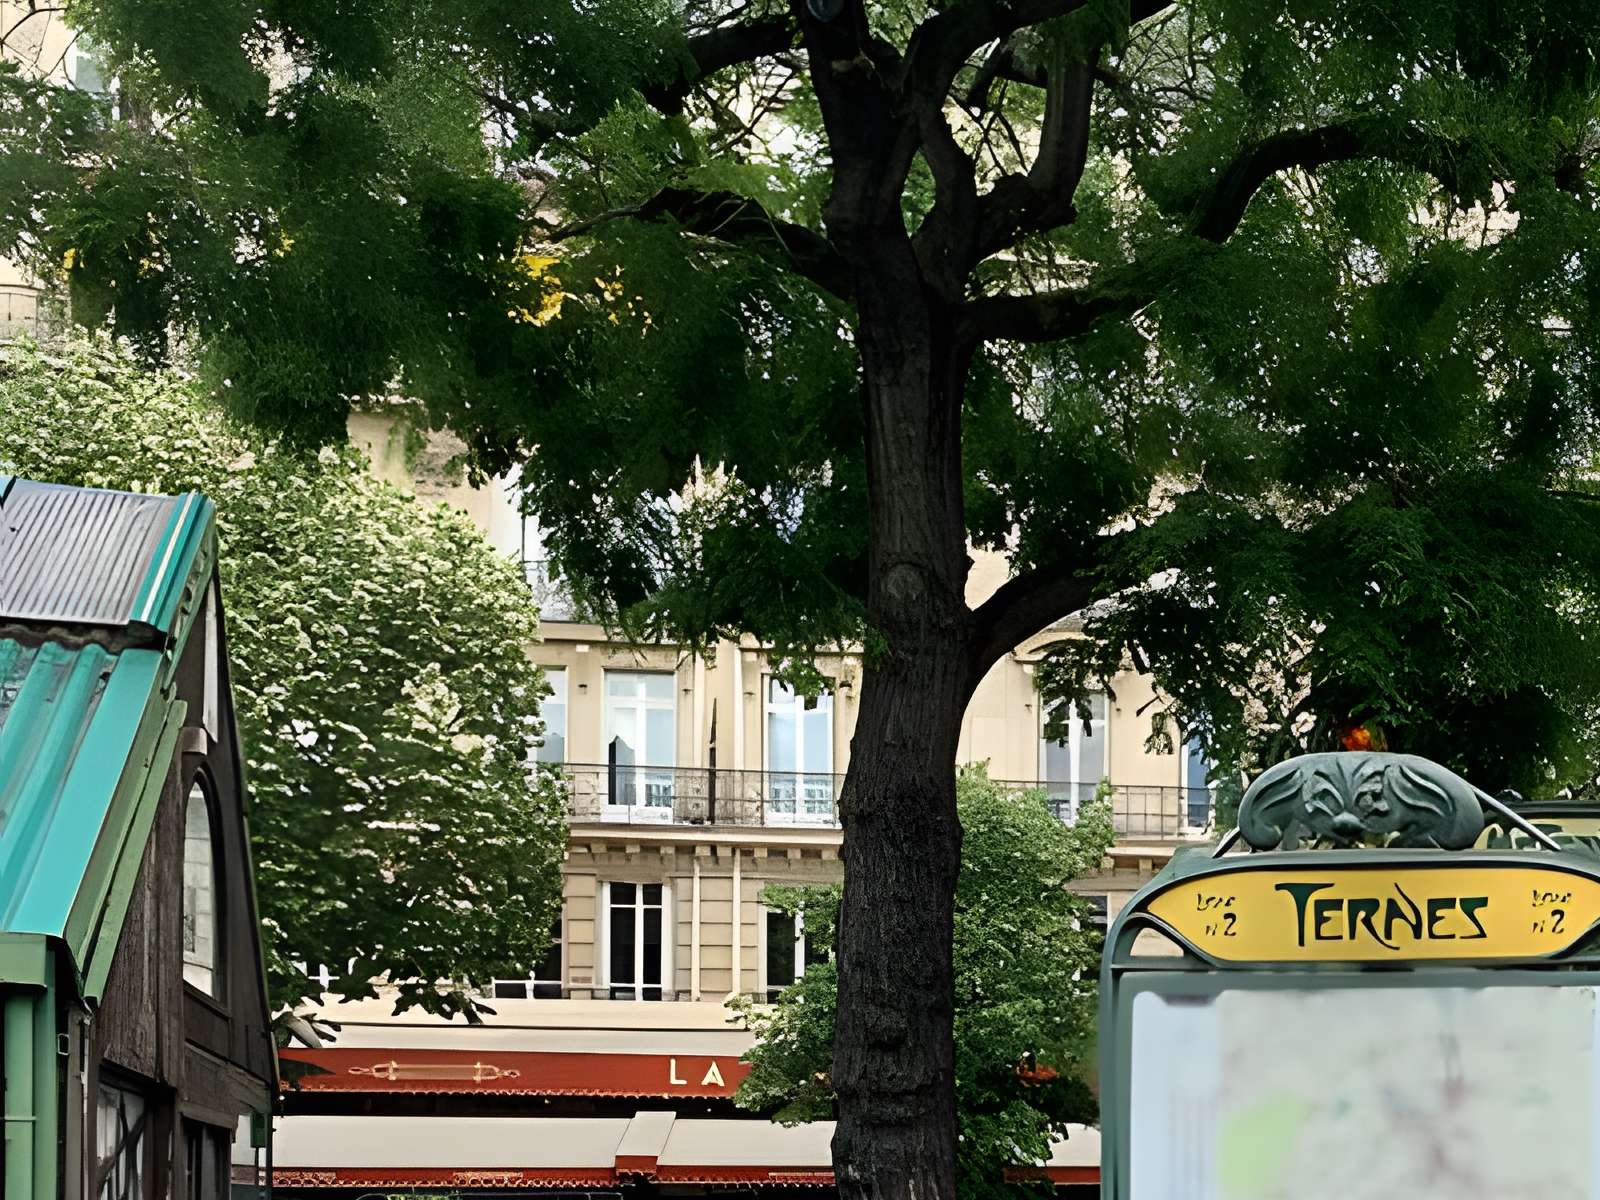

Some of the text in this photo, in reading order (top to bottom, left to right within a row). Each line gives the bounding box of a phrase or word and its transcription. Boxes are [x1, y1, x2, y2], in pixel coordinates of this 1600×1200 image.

[1223, 912, 1237, 936] 2
[1275, 883, 1489, 951] TERNES
[1551, 909, 1565, 934] 2
[669, 1058, 725, 1087] LA
